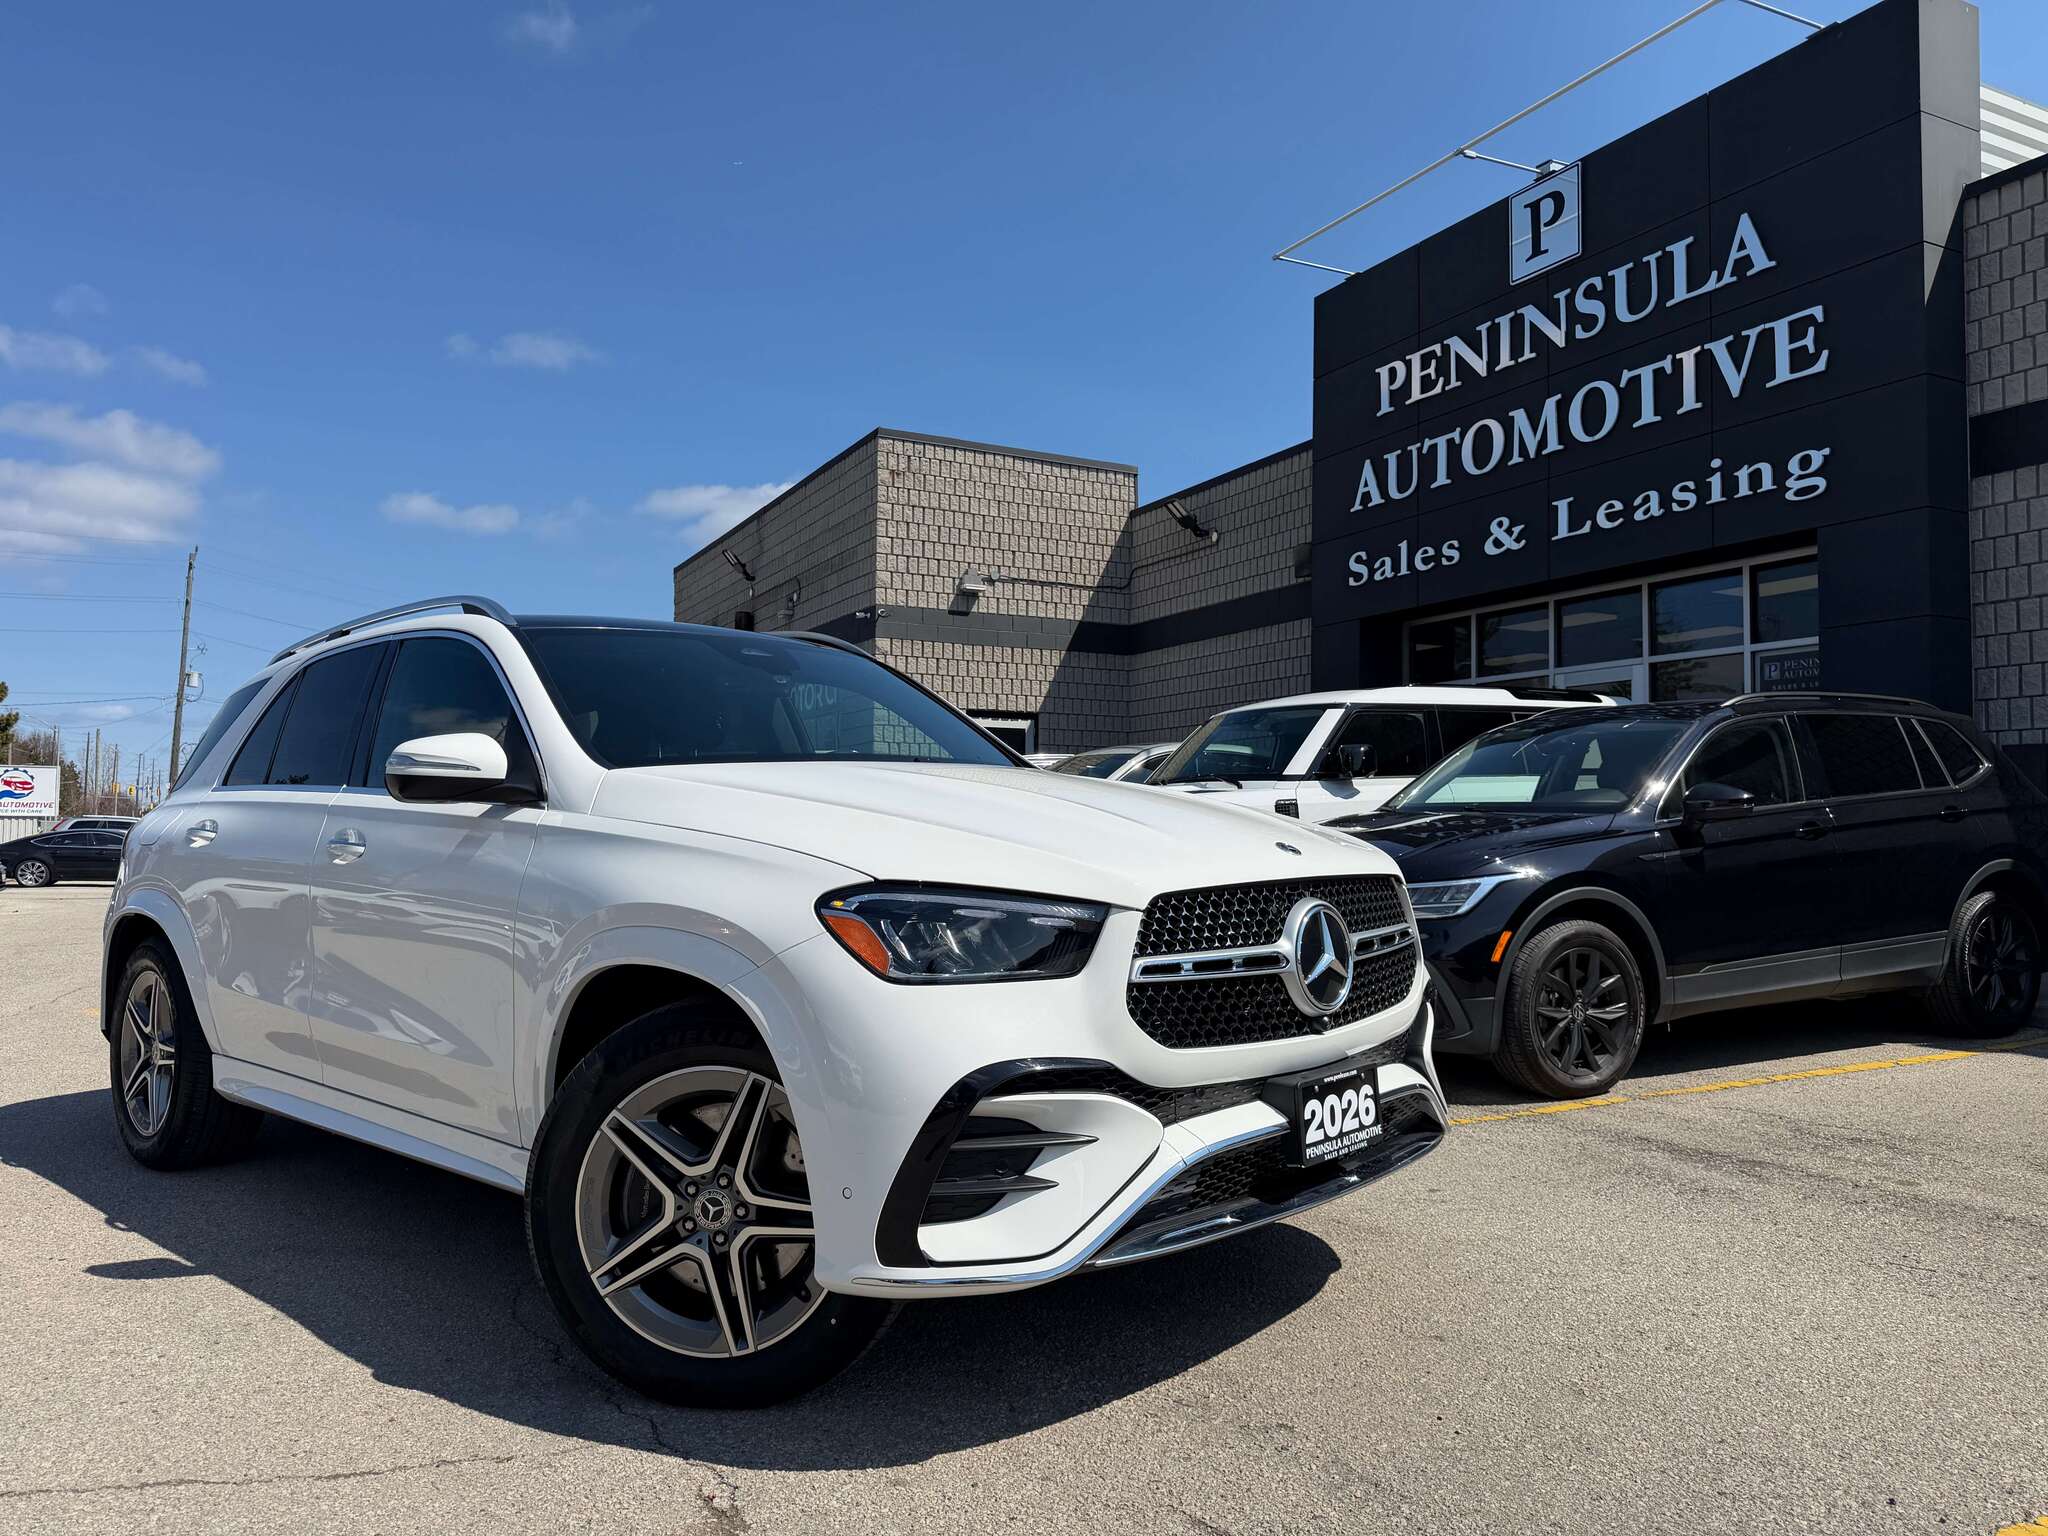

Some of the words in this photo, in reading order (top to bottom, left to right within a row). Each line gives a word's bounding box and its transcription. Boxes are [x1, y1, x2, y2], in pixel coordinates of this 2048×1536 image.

[1523, 190, 1566, 264] P
[1375, 212, 1777, 417] PENINSULA
[1350, 304, 1831, 513] AUTOMOTIVE
[1348, 538, 1461, 587] Sales
[1483, 516, 1527, 557] &
[1551, 446, 1831, 541] Leasing
[1304, 1084, 1375, 1144] 2026
[1306, 1138, 1342, 1160] PENINSULA
[1342, 1124, 1382, 1147] AUTOMOTIVE
[1324, 1150, 1338, 1160] SALES
[1339, 1146, 1349, 1155] AND
[1349, 1140, 1368, 1152] LEASING
